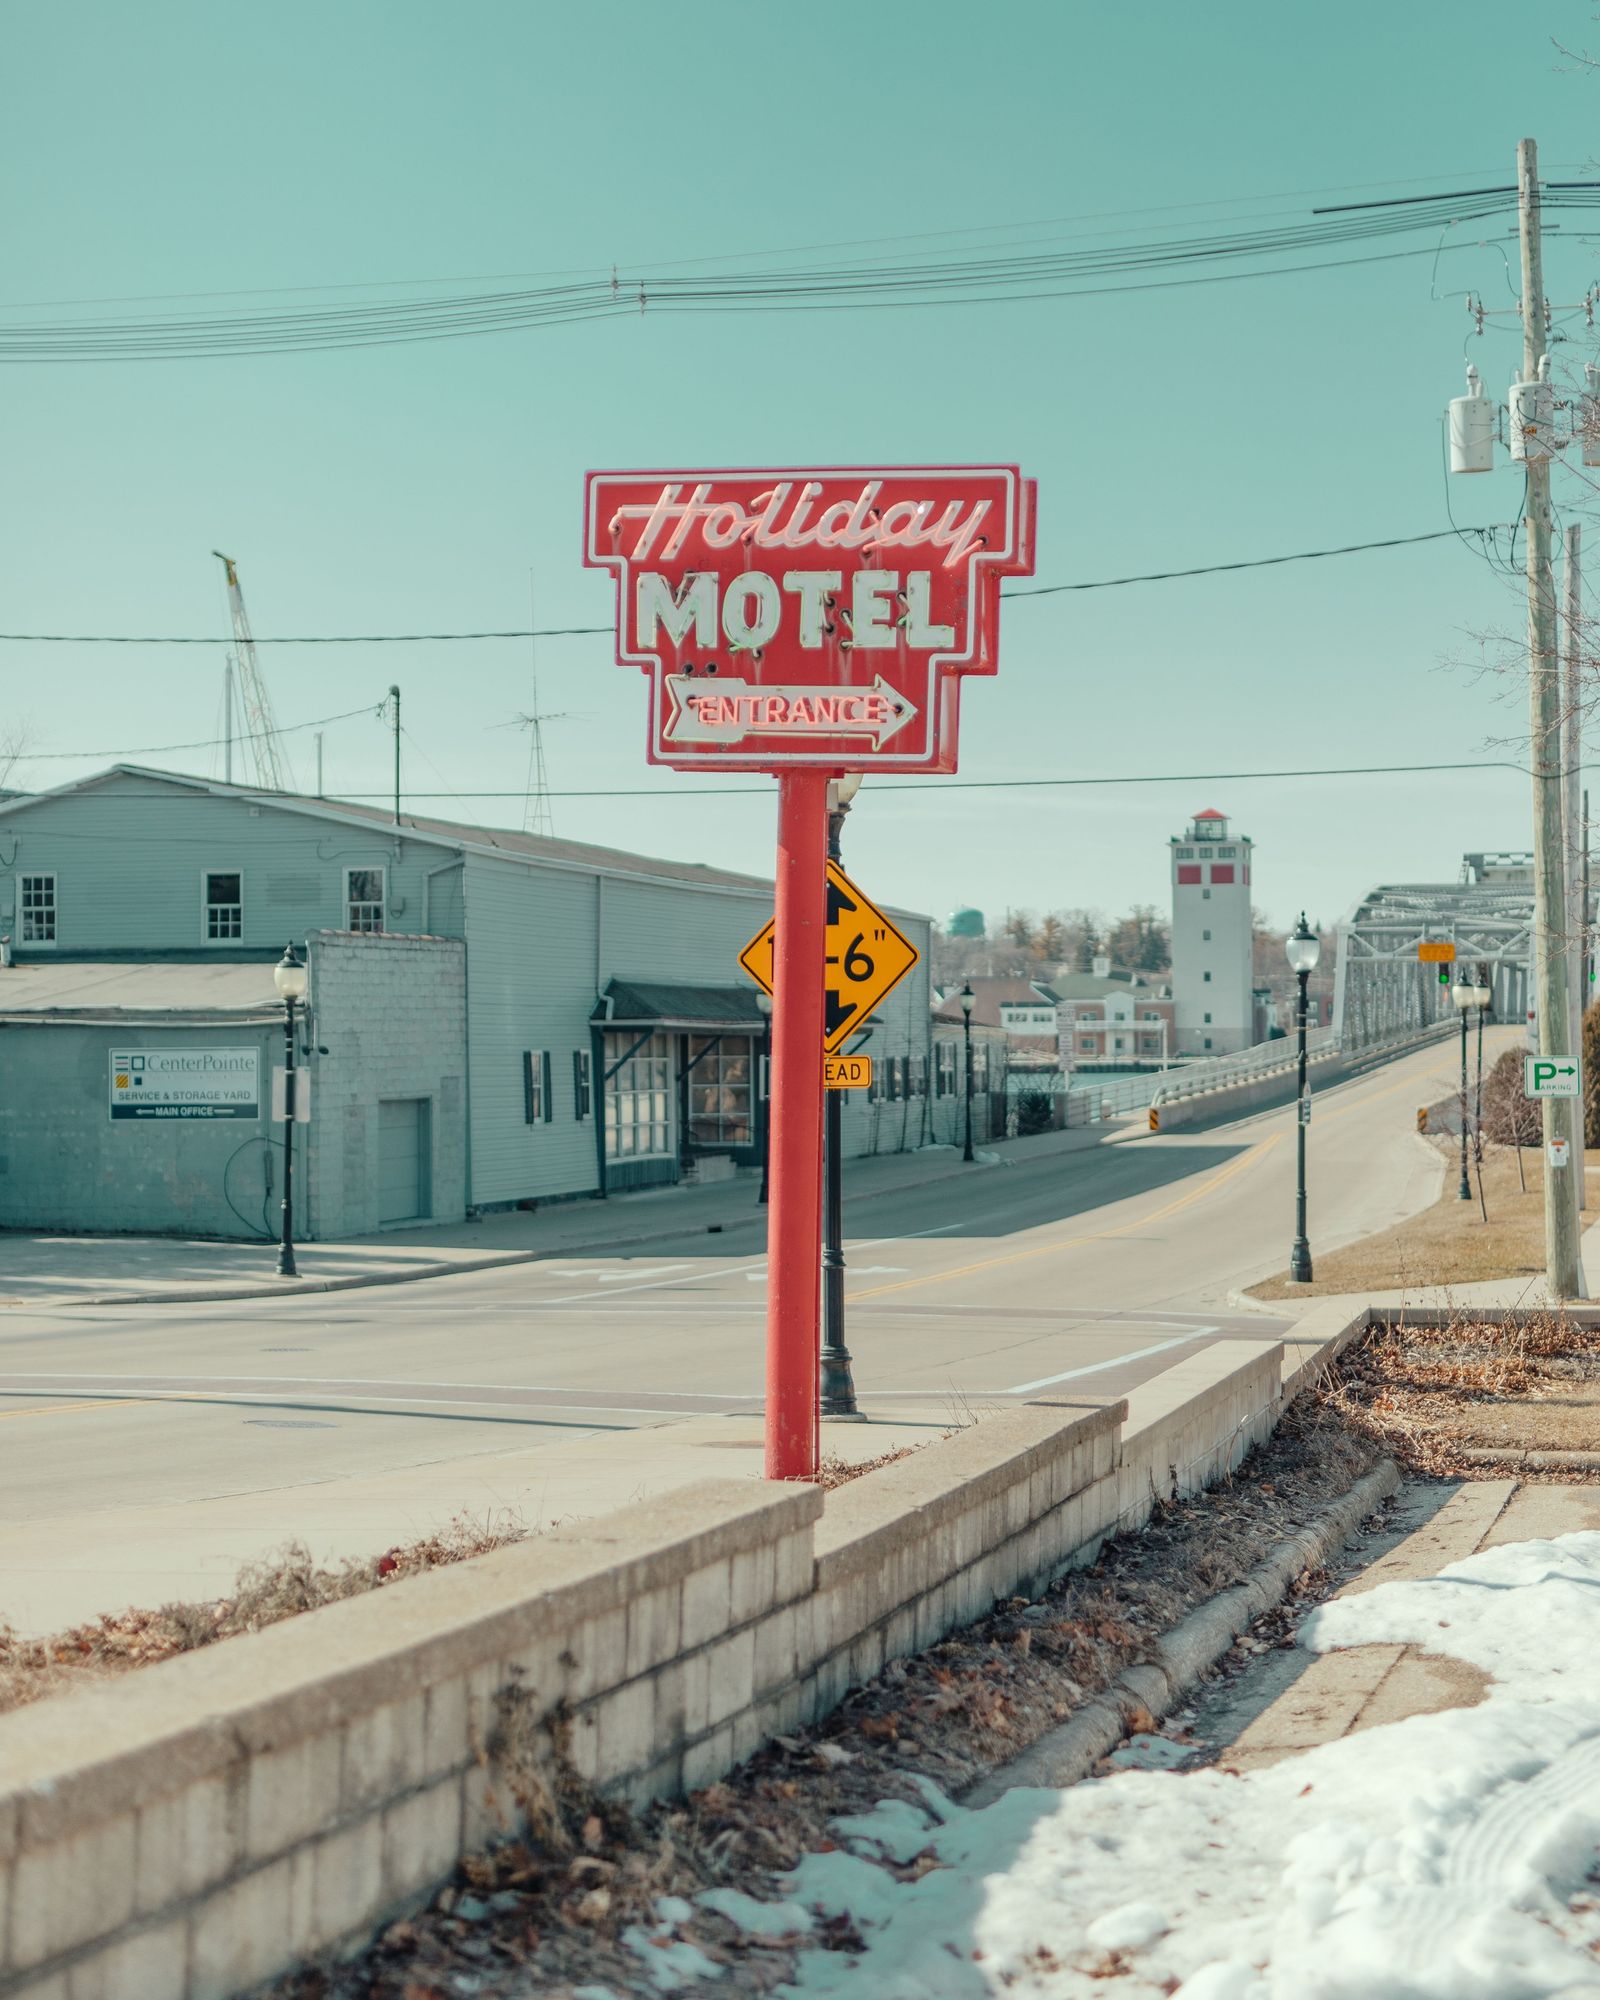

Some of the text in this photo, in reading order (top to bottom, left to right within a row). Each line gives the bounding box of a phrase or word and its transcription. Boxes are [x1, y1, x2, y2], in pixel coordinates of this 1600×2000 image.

[616, 480, 992, 567] Holiday
[637, 571, 954, 649] MOTEL
[698, 695, 888, 725] ENTRANCE
[148, 1055, 255, 1071] CenterPointe
[825, 1063, 860, 1080] EAD
[118, 1090, 250, 1100] SERVICE & STORAGE YARD
[155, 1105, 214, 1117] MAIN OFFICE
